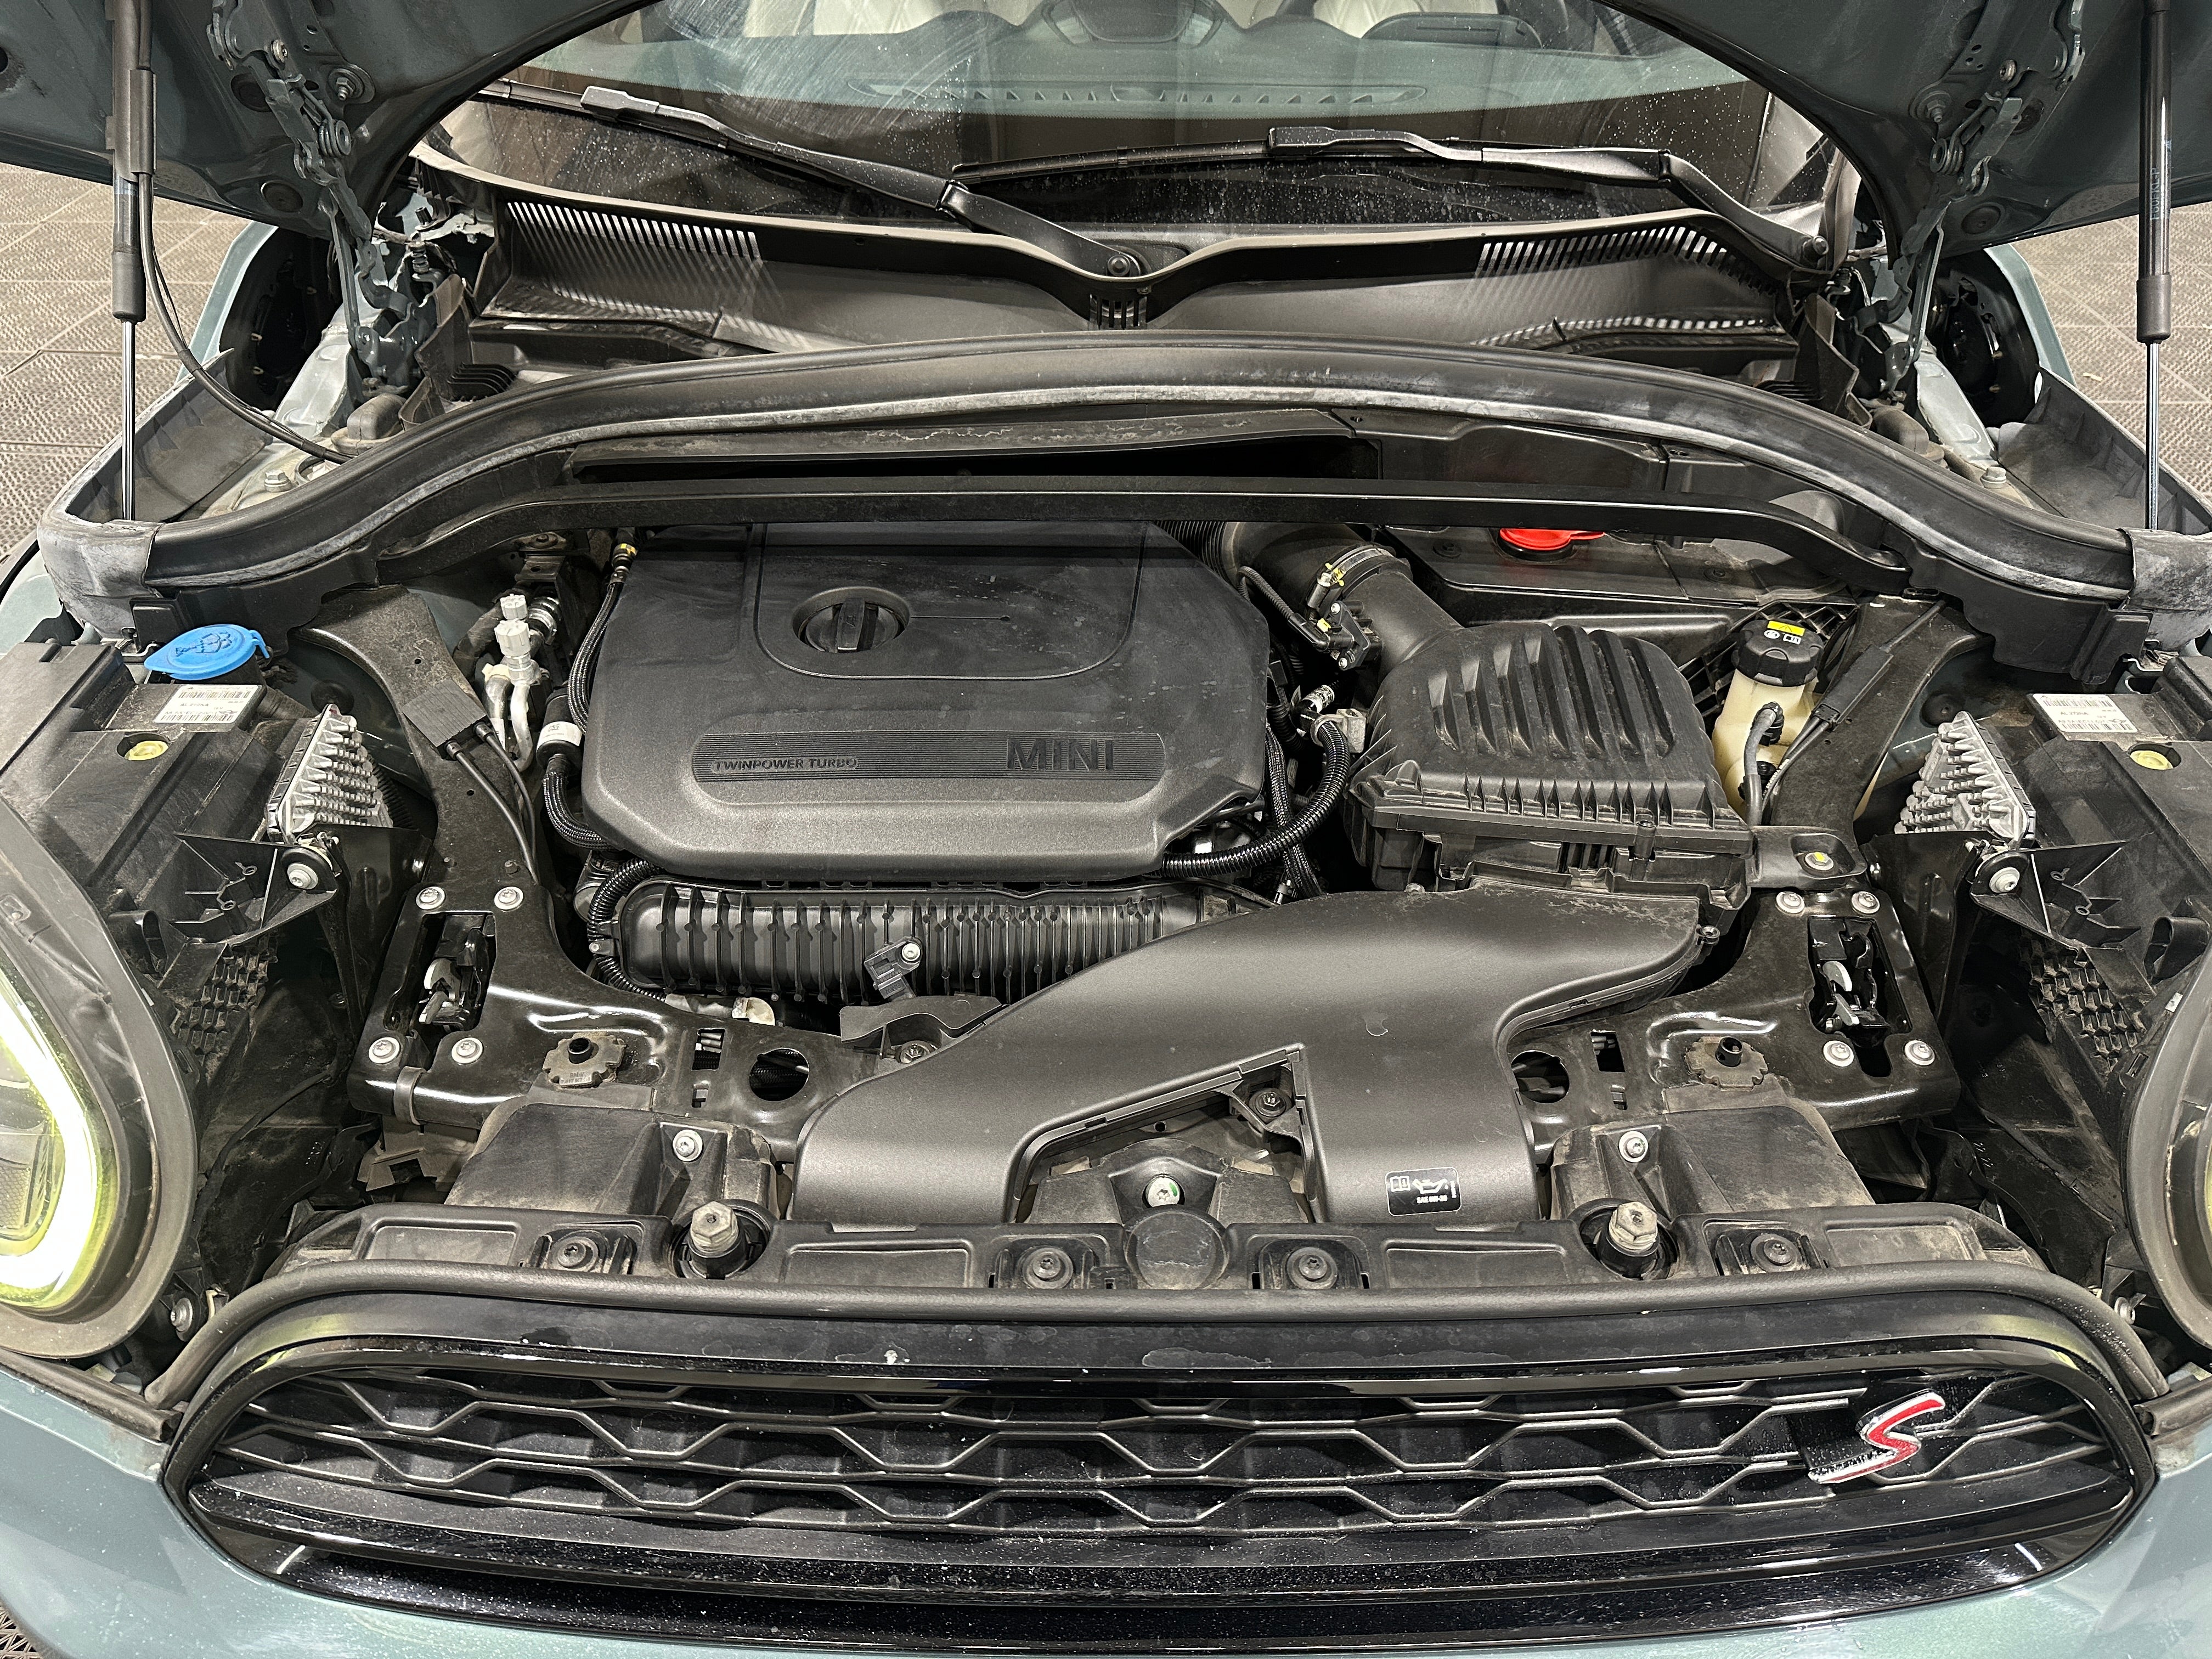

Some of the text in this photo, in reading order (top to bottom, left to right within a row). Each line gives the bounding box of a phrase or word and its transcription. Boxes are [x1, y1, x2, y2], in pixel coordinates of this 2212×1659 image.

[715, 757, 857, 770] TWINPOWER TURBO
[1007, 738, 1113, 770] MINI
[1807, 1389, 1946, 1484] S
